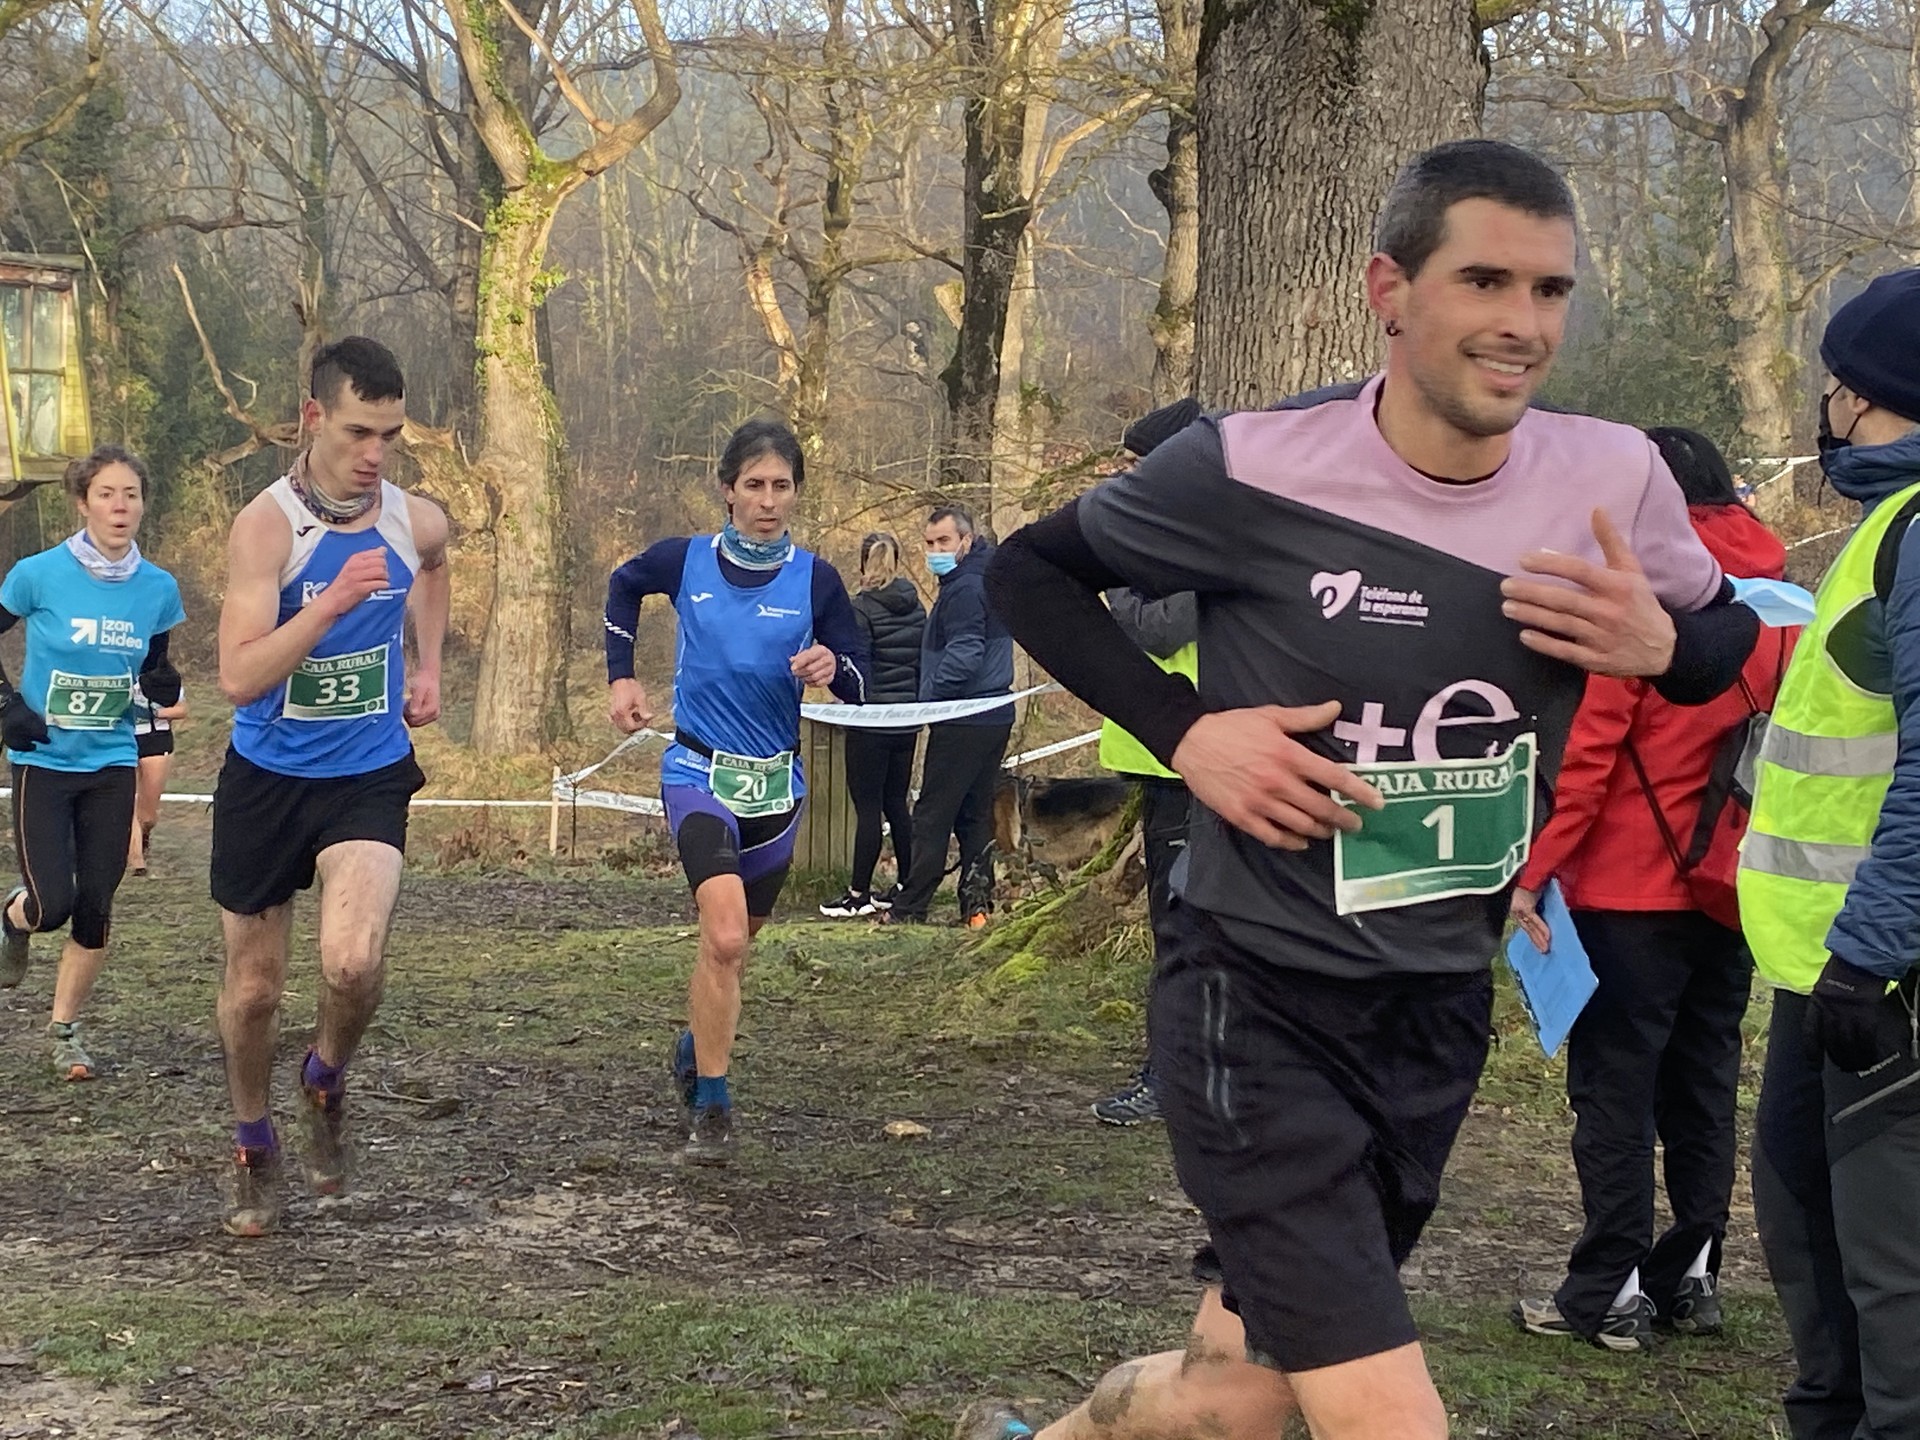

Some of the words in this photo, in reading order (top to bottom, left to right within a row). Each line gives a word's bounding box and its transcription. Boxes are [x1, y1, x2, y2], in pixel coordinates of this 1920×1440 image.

[101, 616, 134, 633] izan
[100, 632, 143, 649] bidea
[336, 652, 380, 671] RURAL
[315, 674, 360, 705] 33
[67, 691, 107, 715] 87
[733, 774, 767, 801] 20
[1421, 804, 1455, 861] 1
